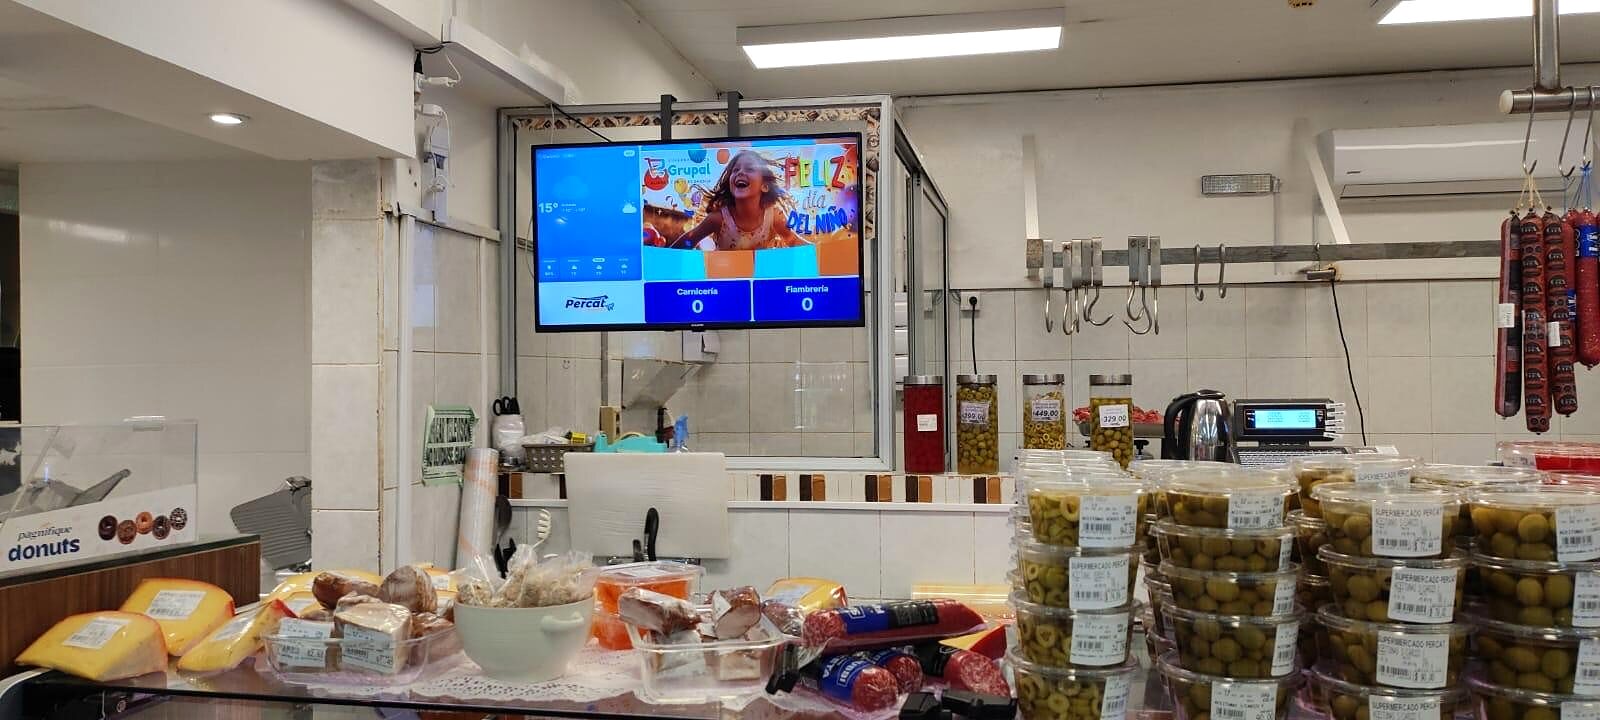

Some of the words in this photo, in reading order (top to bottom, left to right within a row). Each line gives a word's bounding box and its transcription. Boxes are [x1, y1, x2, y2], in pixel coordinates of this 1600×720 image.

[668, 163, 711, 178] Grupal
[784, 155, 846, 190] FELIZ
[785, 210, 813, 235] DEL
[815, 205, 848, 235] NIÑO
[676, 287, 718, 296] Carnicería
[785, 285, 829, 294] Fiambrería
[566, 298, 606, 309] Percat
[692, 300, 704, 313] 0
[802, 297, 813, 311] 0
[8, 538, 81, 562] donuts
